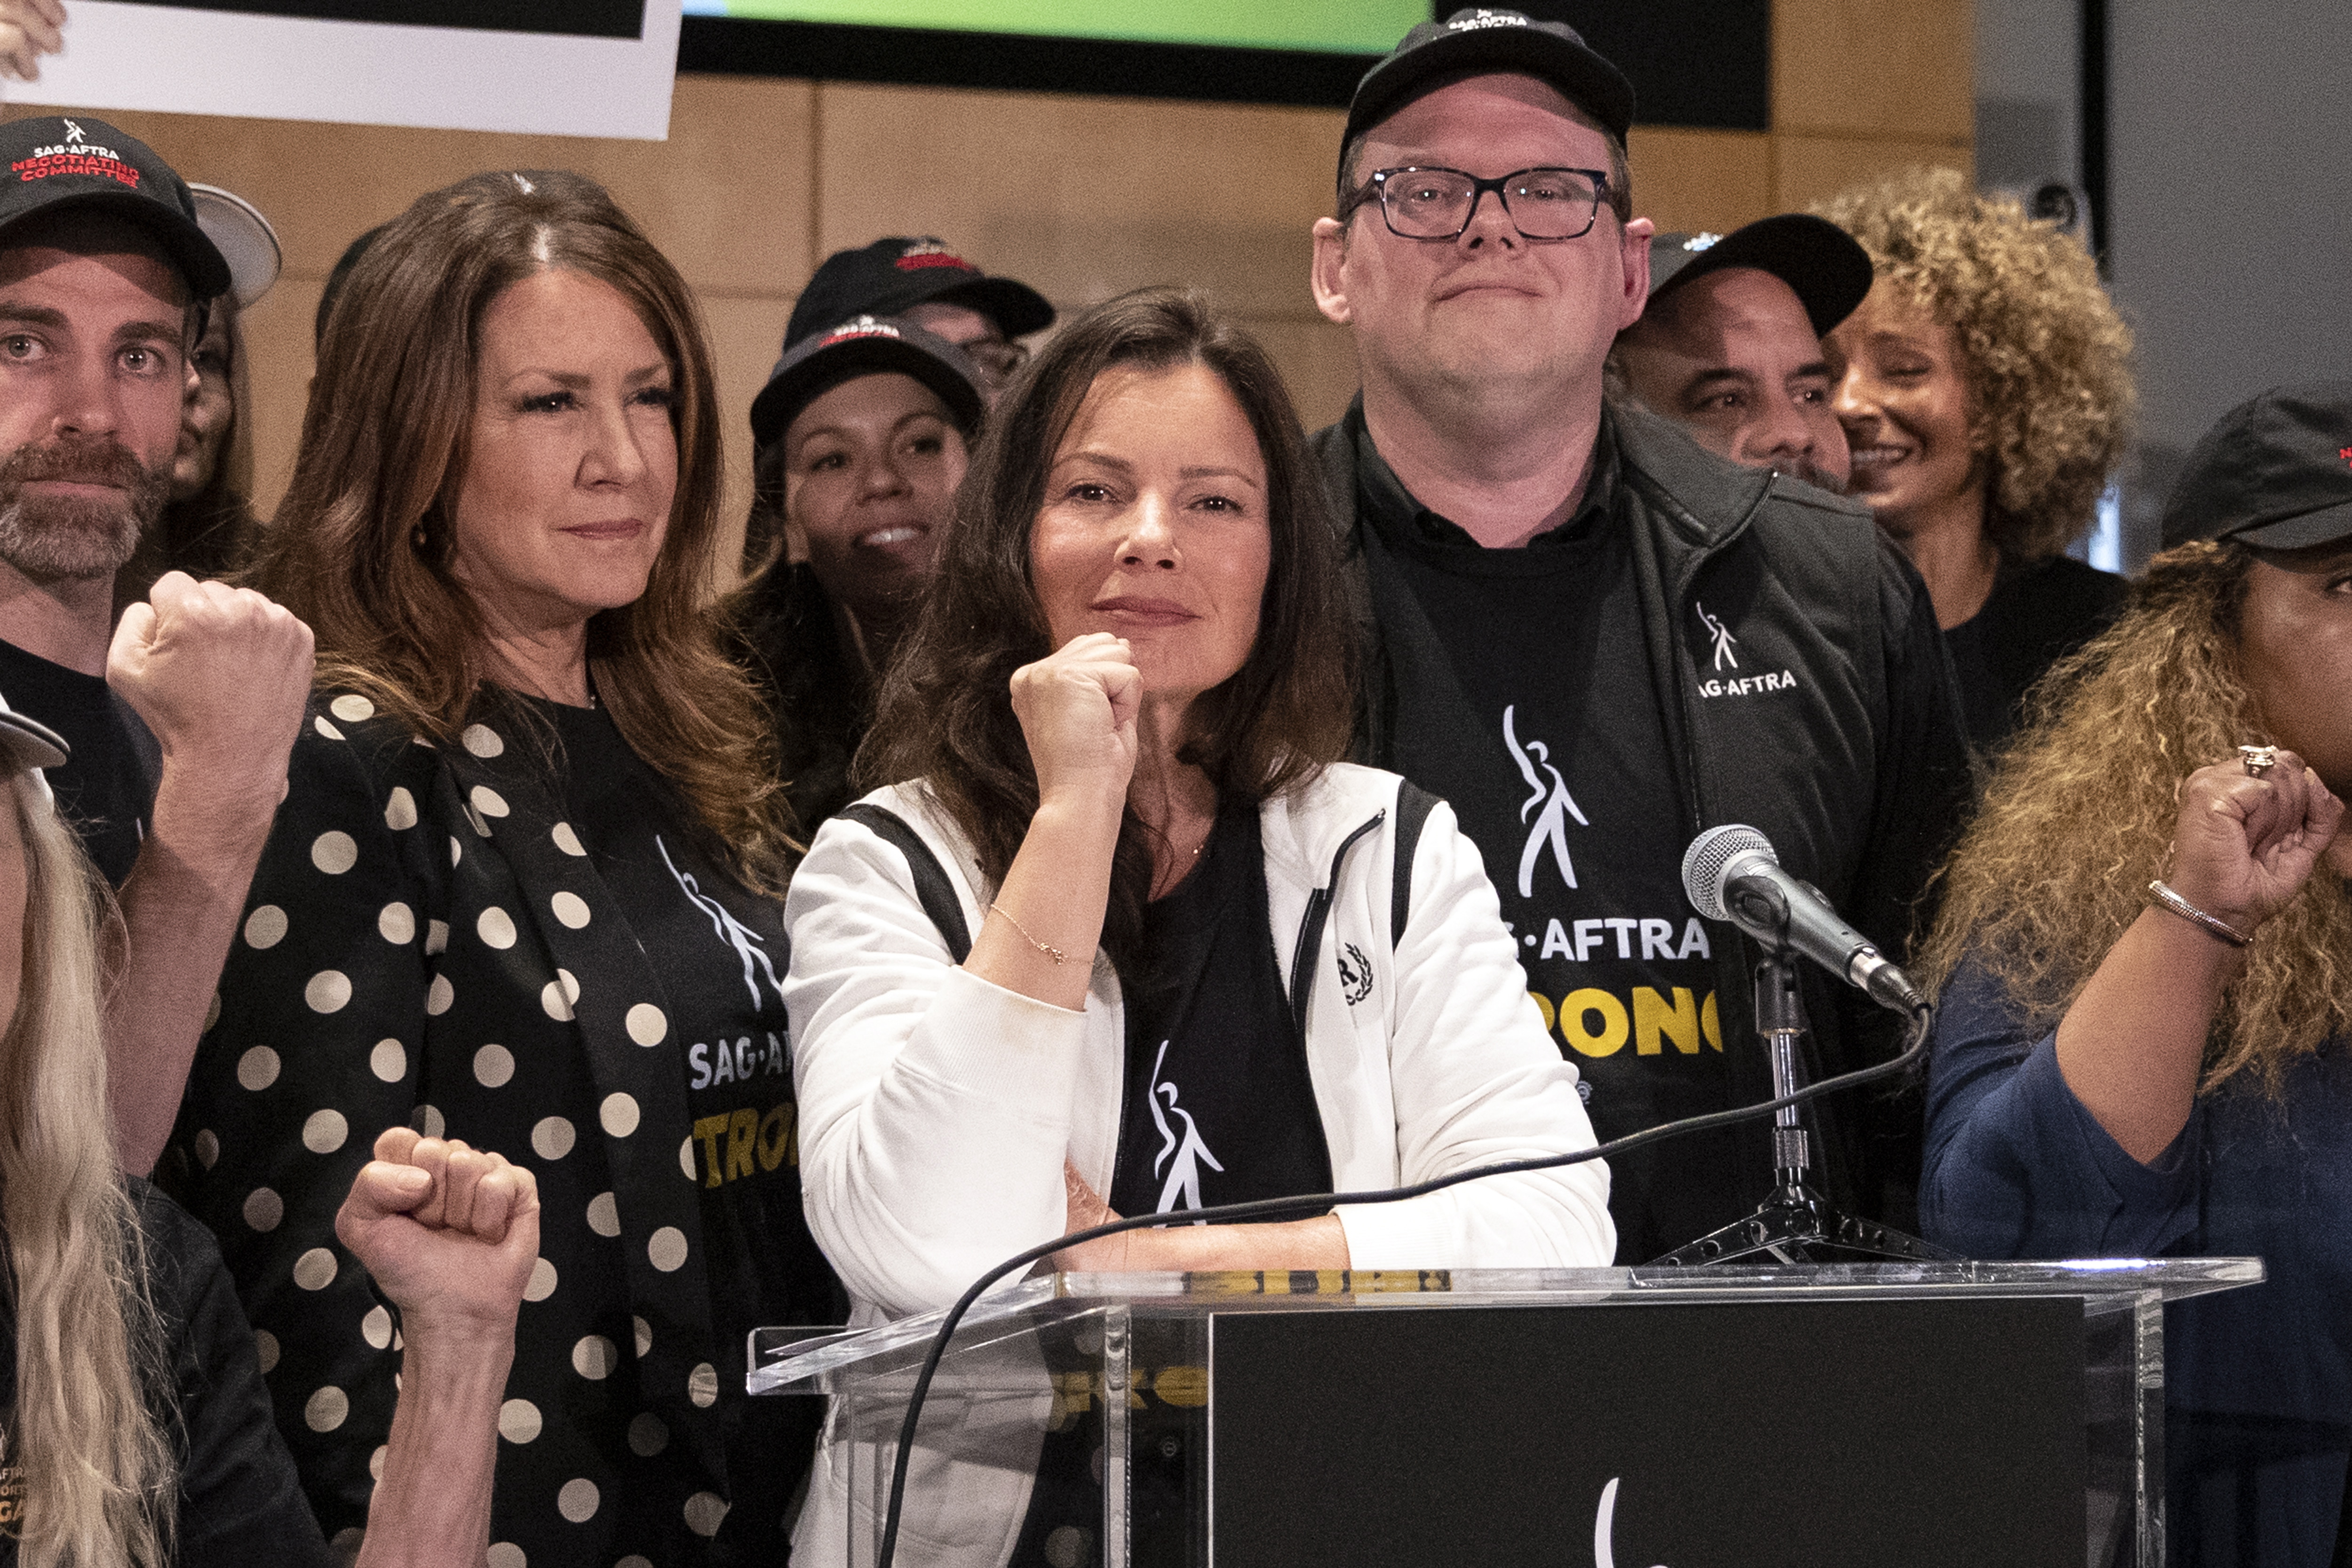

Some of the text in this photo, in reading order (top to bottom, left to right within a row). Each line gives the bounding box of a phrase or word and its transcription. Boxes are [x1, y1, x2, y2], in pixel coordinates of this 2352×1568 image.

[34, 144, 120, 161] SAG·AFTRA
[11, 154, 140, 181] NEGOTIATING
[20, 164, 138, 189] COMMITTEE
